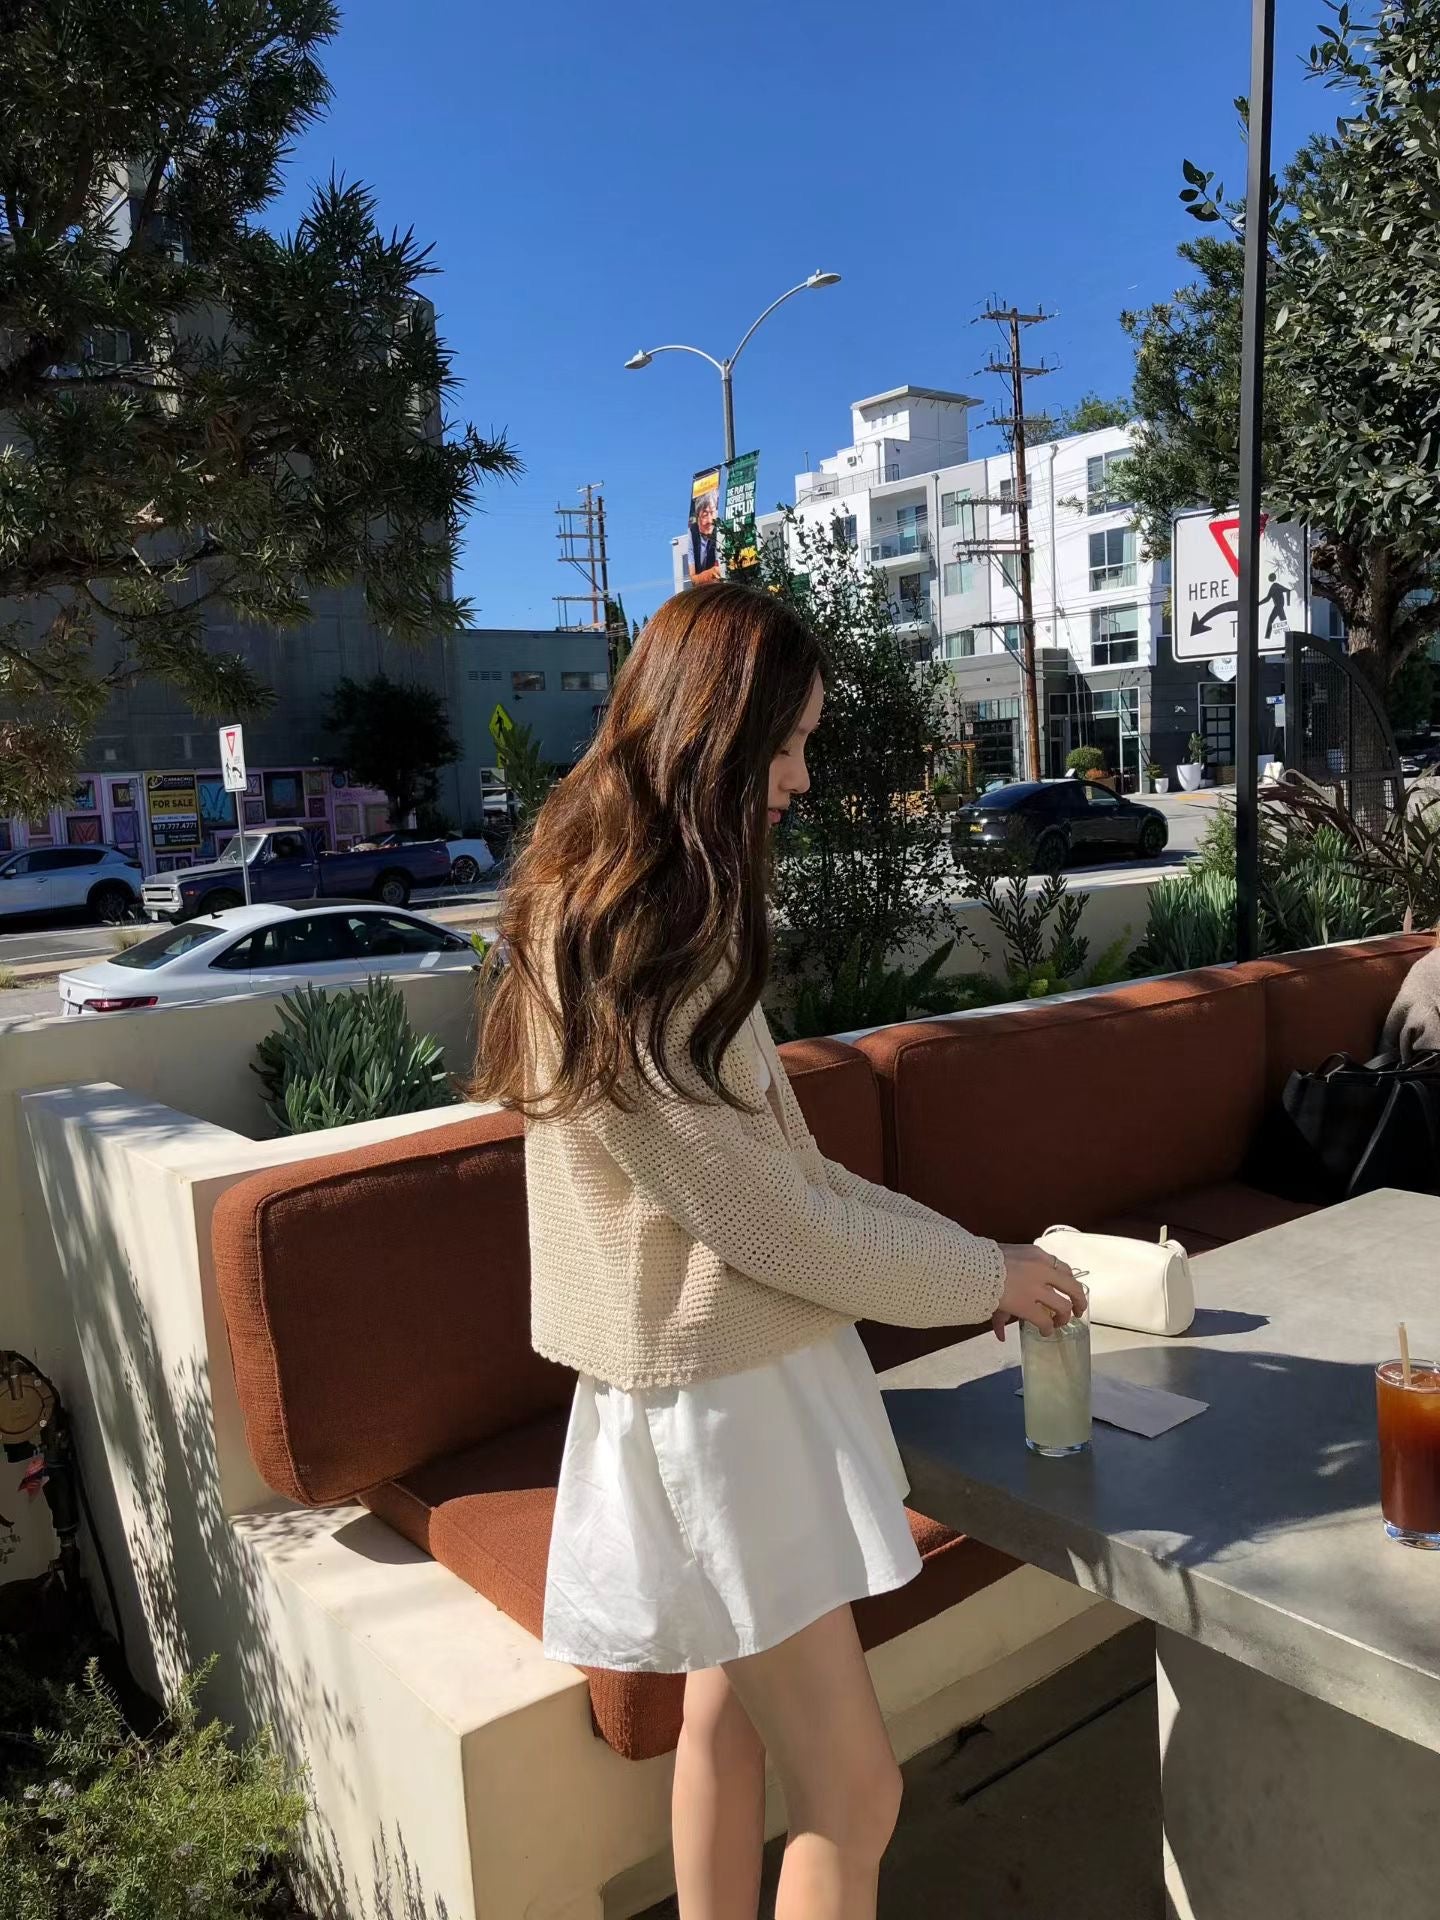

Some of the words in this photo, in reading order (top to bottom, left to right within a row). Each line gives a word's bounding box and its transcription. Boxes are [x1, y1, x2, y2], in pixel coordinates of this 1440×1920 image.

[726, 499, 754, 520] NETFLIX
[1189, 579, 1230, 601] HERE
[1230, 621, 1238, 638] T
[153, 799, 170, 808] FOR
[172, 799, 193, 807] SALE
